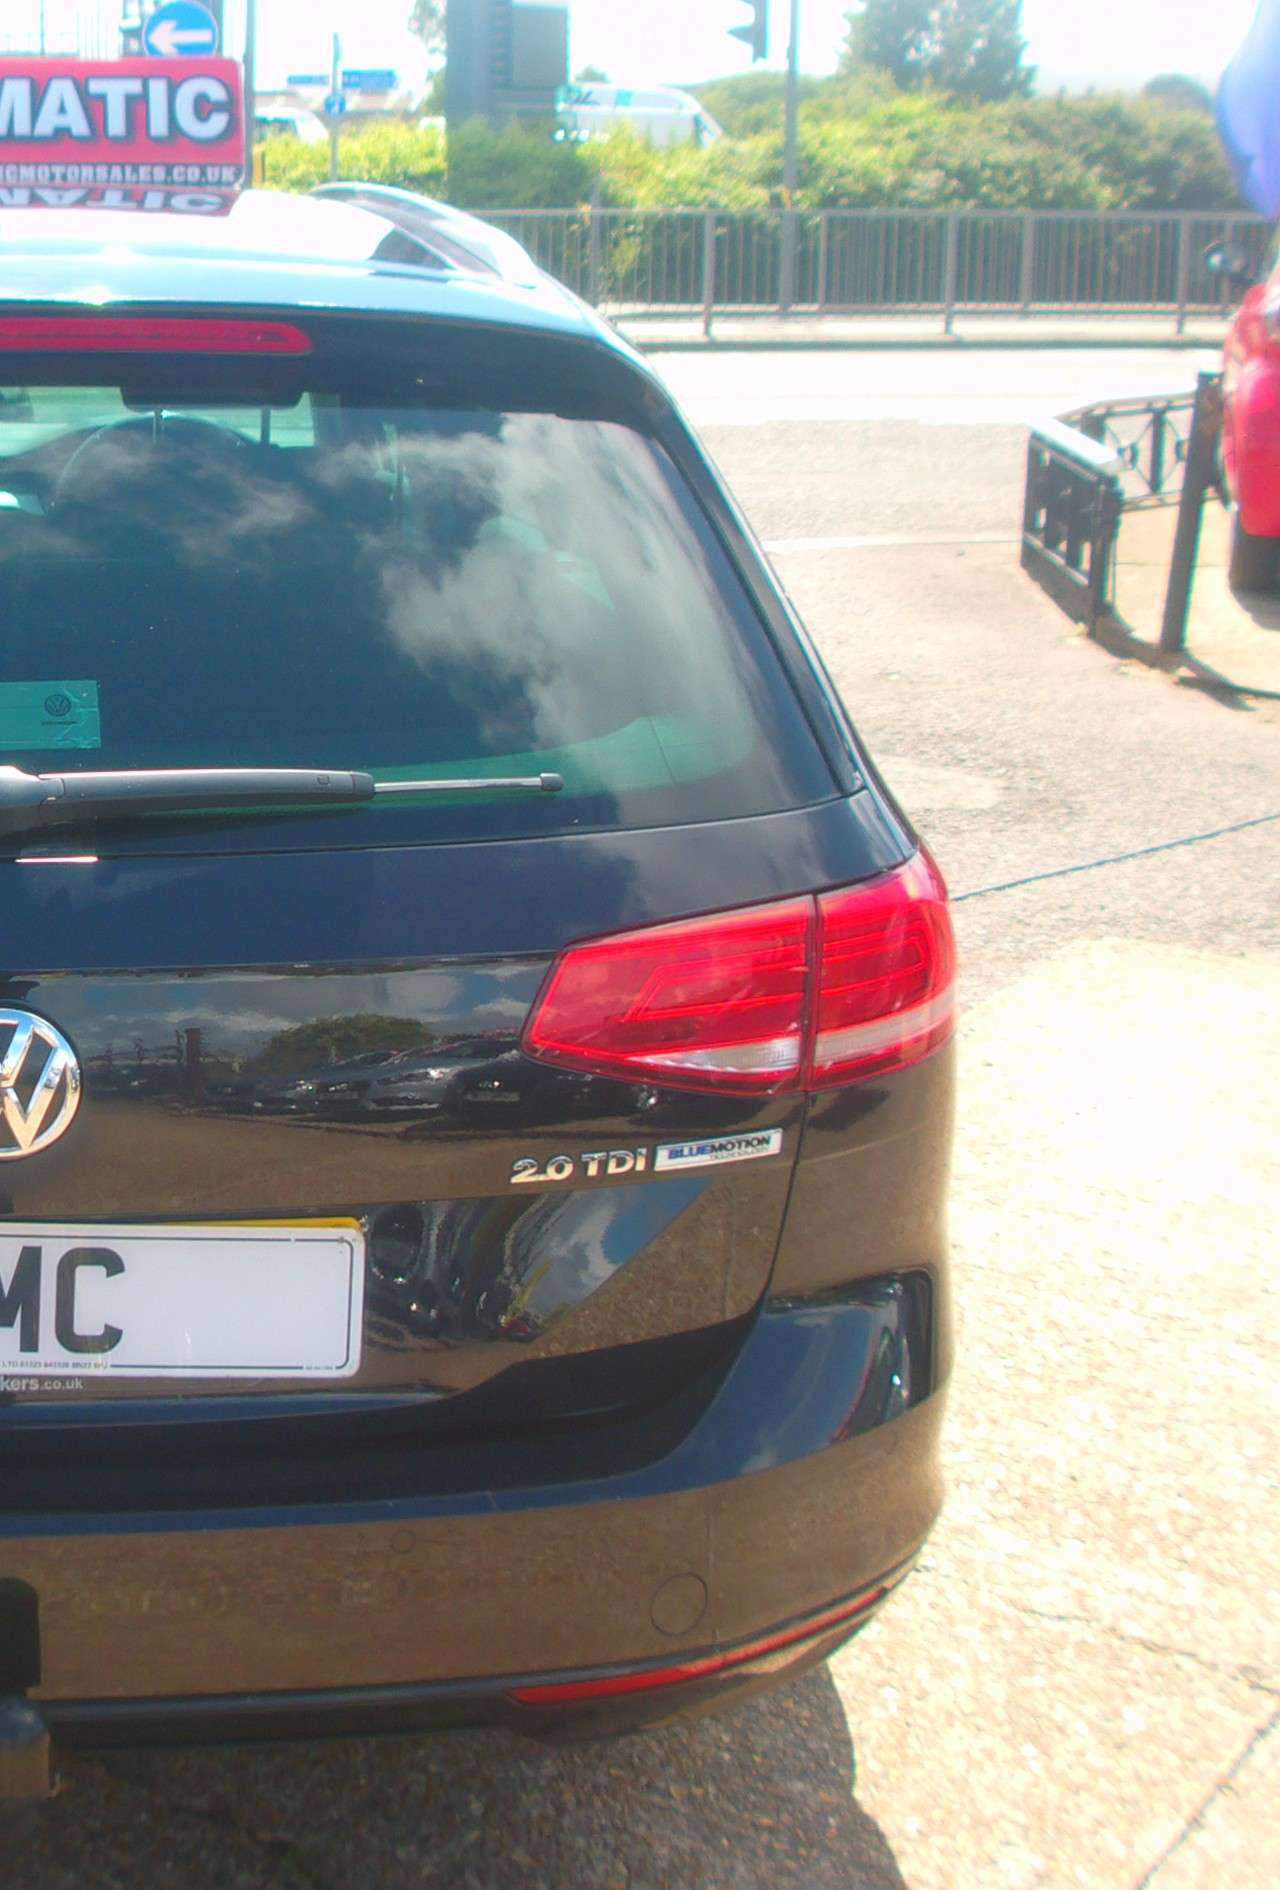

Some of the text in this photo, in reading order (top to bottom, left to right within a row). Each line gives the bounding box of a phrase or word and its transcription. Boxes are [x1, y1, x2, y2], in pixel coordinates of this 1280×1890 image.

[667, 1134, 771, 1160] BLUEMOTION
[510, 1147, 648, 1184] 2.0 TDI
